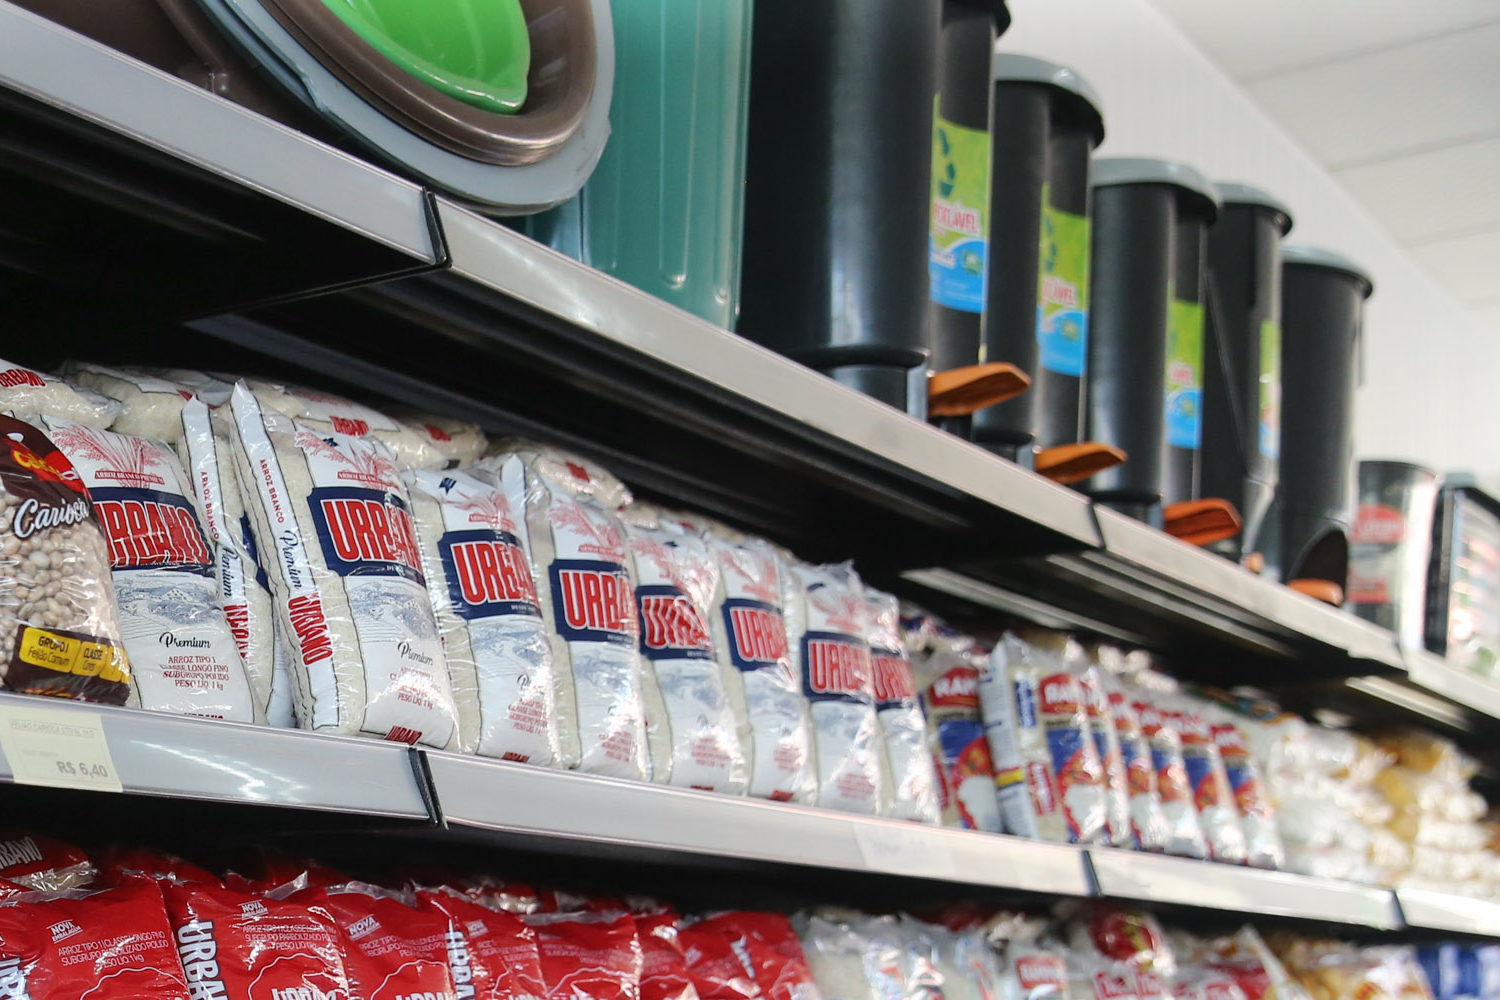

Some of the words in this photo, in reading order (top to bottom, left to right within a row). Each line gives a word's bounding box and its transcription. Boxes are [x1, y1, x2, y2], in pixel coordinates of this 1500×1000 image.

[199, 470, 212, 502] ARROZ
[258, 458, 274, 488] ARROZ
[267, 488, 286, 525] BRANCO
[204, 502, 221, 541] BRANCO
[286, 592, 335, 667] URBANO
[158, 631, 212, 649] Premium
[83, 647, 104, 661] CLASSE
[168, 655, 194, 664] ARROZ
[194, 655, 212, 663] TIPO
[187, 664, 213, 673] LONGO
[213, 665, 229, 674] FINO
[56, 761, 77, 776] R$
[79, 762, 109, 779] 6,40
[241, 902, 265, 914] NOVA
[51, 921, 75, 936] NOVA
[349, 915, 379, 935] NOVA
[58, 945, 82, 956] ARROZ
[82, 941, 98, 952] TIPO
[61, 950, 101, 967] SUBGRUPO
